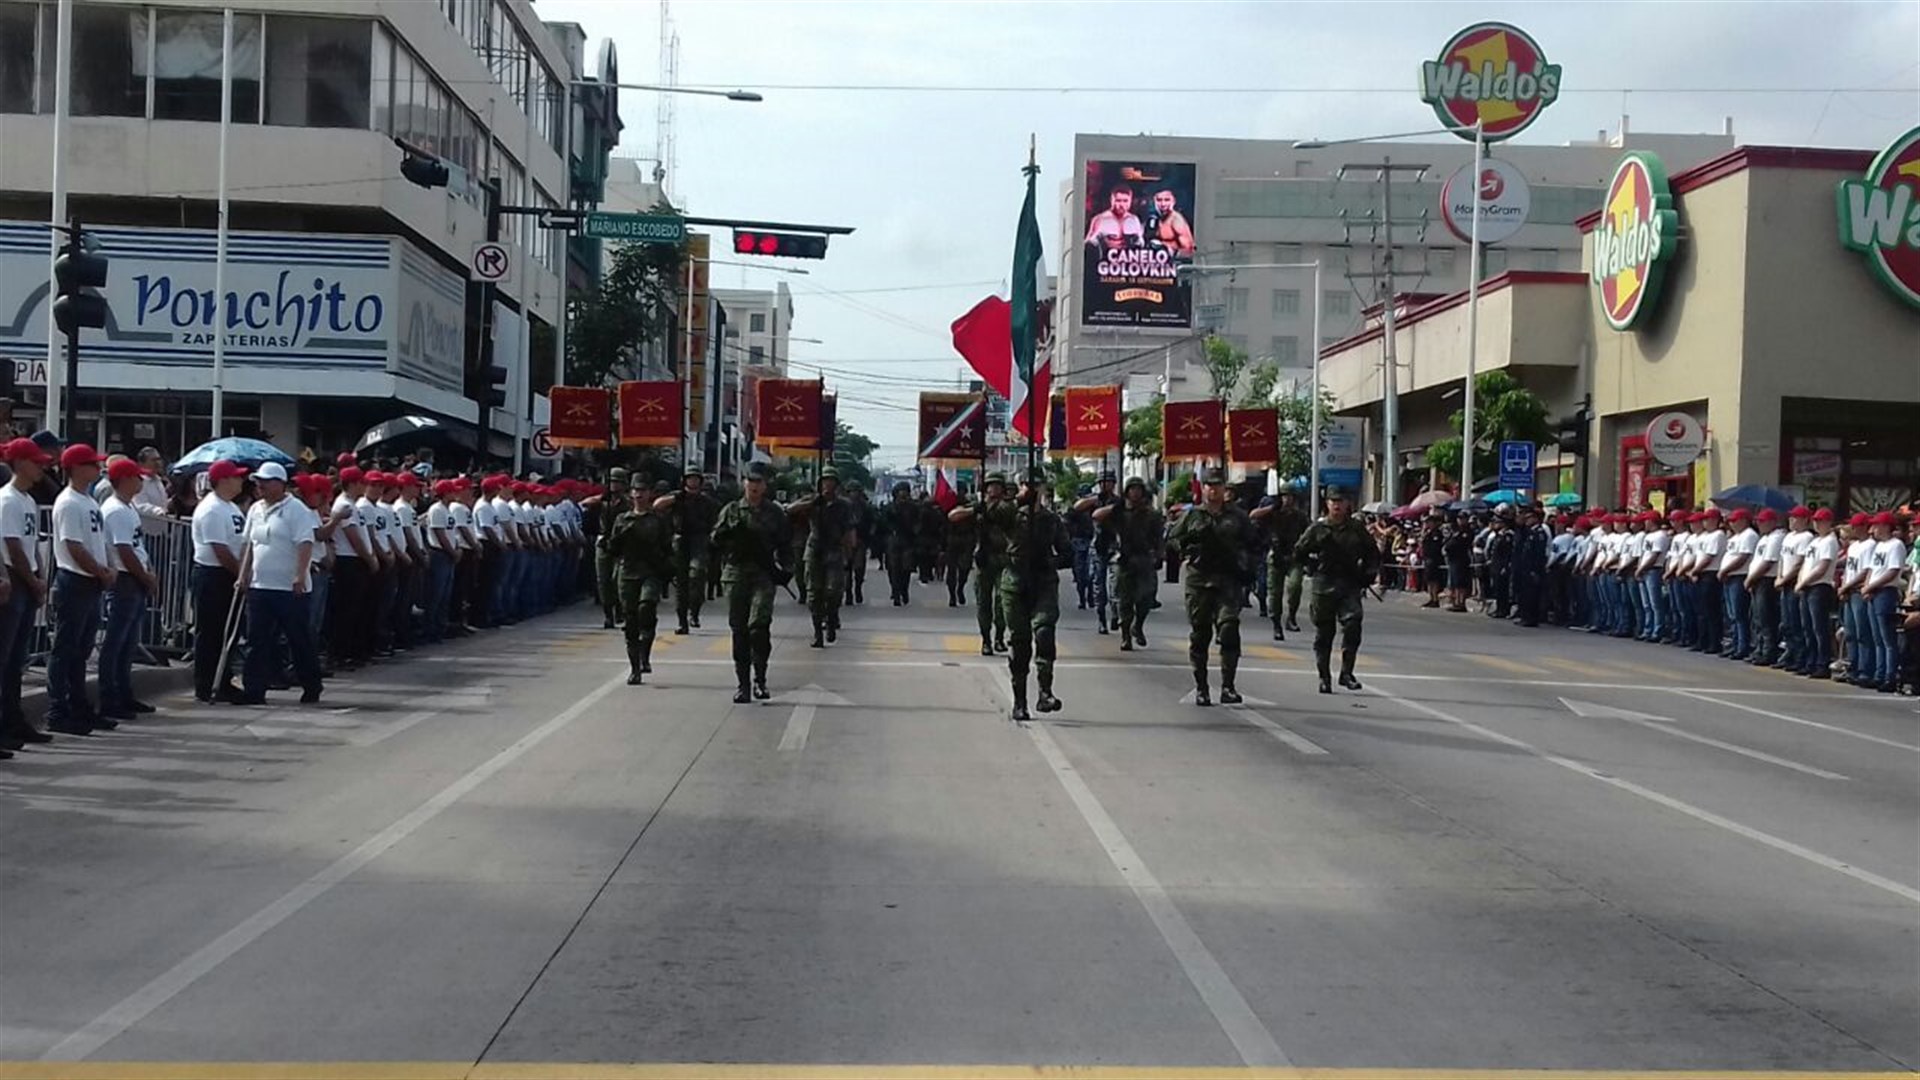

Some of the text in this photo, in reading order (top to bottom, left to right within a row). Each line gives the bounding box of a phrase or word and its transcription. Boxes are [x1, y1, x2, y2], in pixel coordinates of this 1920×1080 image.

[1426, 59, 1557, 101] Waldo's
[589, 220, 680, 238] MARIANO ESCOBEDO
[1595, 198, 1662, 279] Waldo's
[1107, 248, 1169, 264] CANELO
[1097, 261, 1177, 278] GOLOVKIN
[132, 270, 384, 347] Ponchito
[182, 333, 289, 348] ZAPTERIAS
